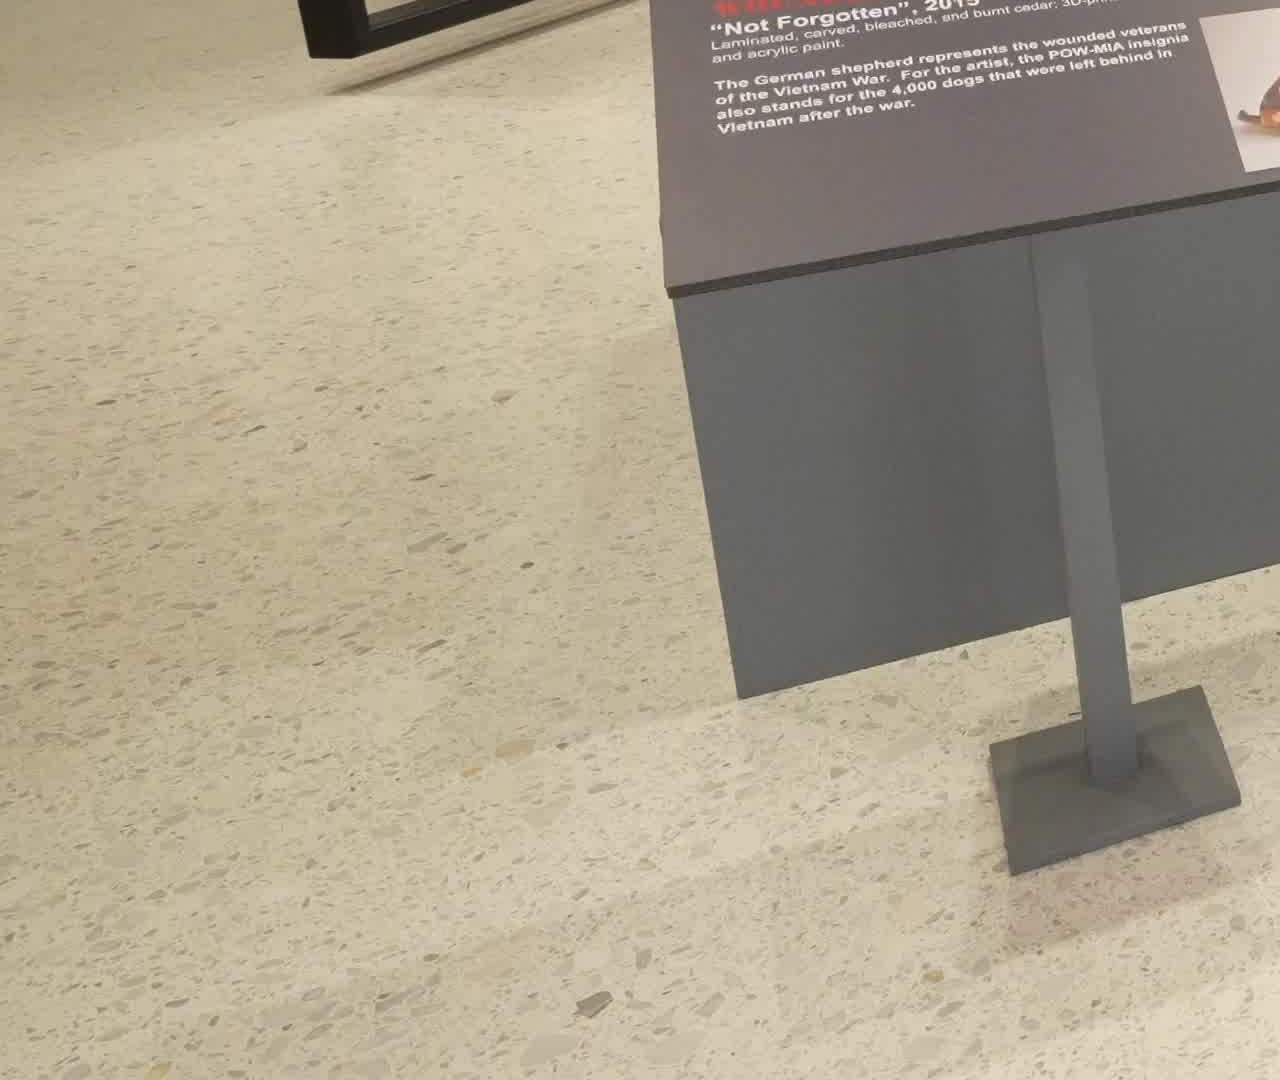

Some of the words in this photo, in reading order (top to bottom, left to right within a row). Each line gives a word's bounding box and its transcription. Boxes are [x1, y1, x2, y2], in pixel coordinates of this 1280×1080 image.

[710, 30, 799, 51] Laminated,
[803, 23, 860, 39] carved,
[863, 14, 937, 32] bleached,
[941, 9, 969, 22] and
[972, 5, 1010, 18] burnt
[711, 50, 742, 64] and
[746, 44, 798, 59] acrylic
[801, 38, 844, 54] paint.
[713, 78, 749, 91] The
[753, 68, 826, 85] German
[830, 55, 913, 76] shepherd
[918, 44, 1008, 64] represents
[1011, 41, 1038, 51] the
[1041, 28, 1116, 47] wounded
[1119, 21, 1187, 37] veterans
[714, 92, 734, 105] of
[738, 90, 769, 102] the
[772, 79, 847, 97] Vietnam
[851, 74, 890, 86] War.
[900, 68, 930, 81] For
[933, 64, 961, 76] the
[965, 56, 1014, 71] artist,
[1047, 41, 1125, 60] POW-MIA
[1127, 33, 1189, 49] insignia
[716, 106, 756, 120] also
[760, 96, 823, 113] stands
[828, 92, 854, 105] for
[858, 88, 887, 100] the
[891, 79, 937, 95] 4,000
[941, 74, 985, 88] dogs
[987, 68, 1022, 82] that
[1024, 63, 1065, 77] were
[1068, 58, 1096, 71] left
[1098, 49, 1154, 66] behind
[1156, 48, 1173, 58] in
[717, 115, 793, 135] Vietnam
[798, 108, 841, 123] after
[845, 104, 874, 117] the
[878, 98, 915, 111] war.
